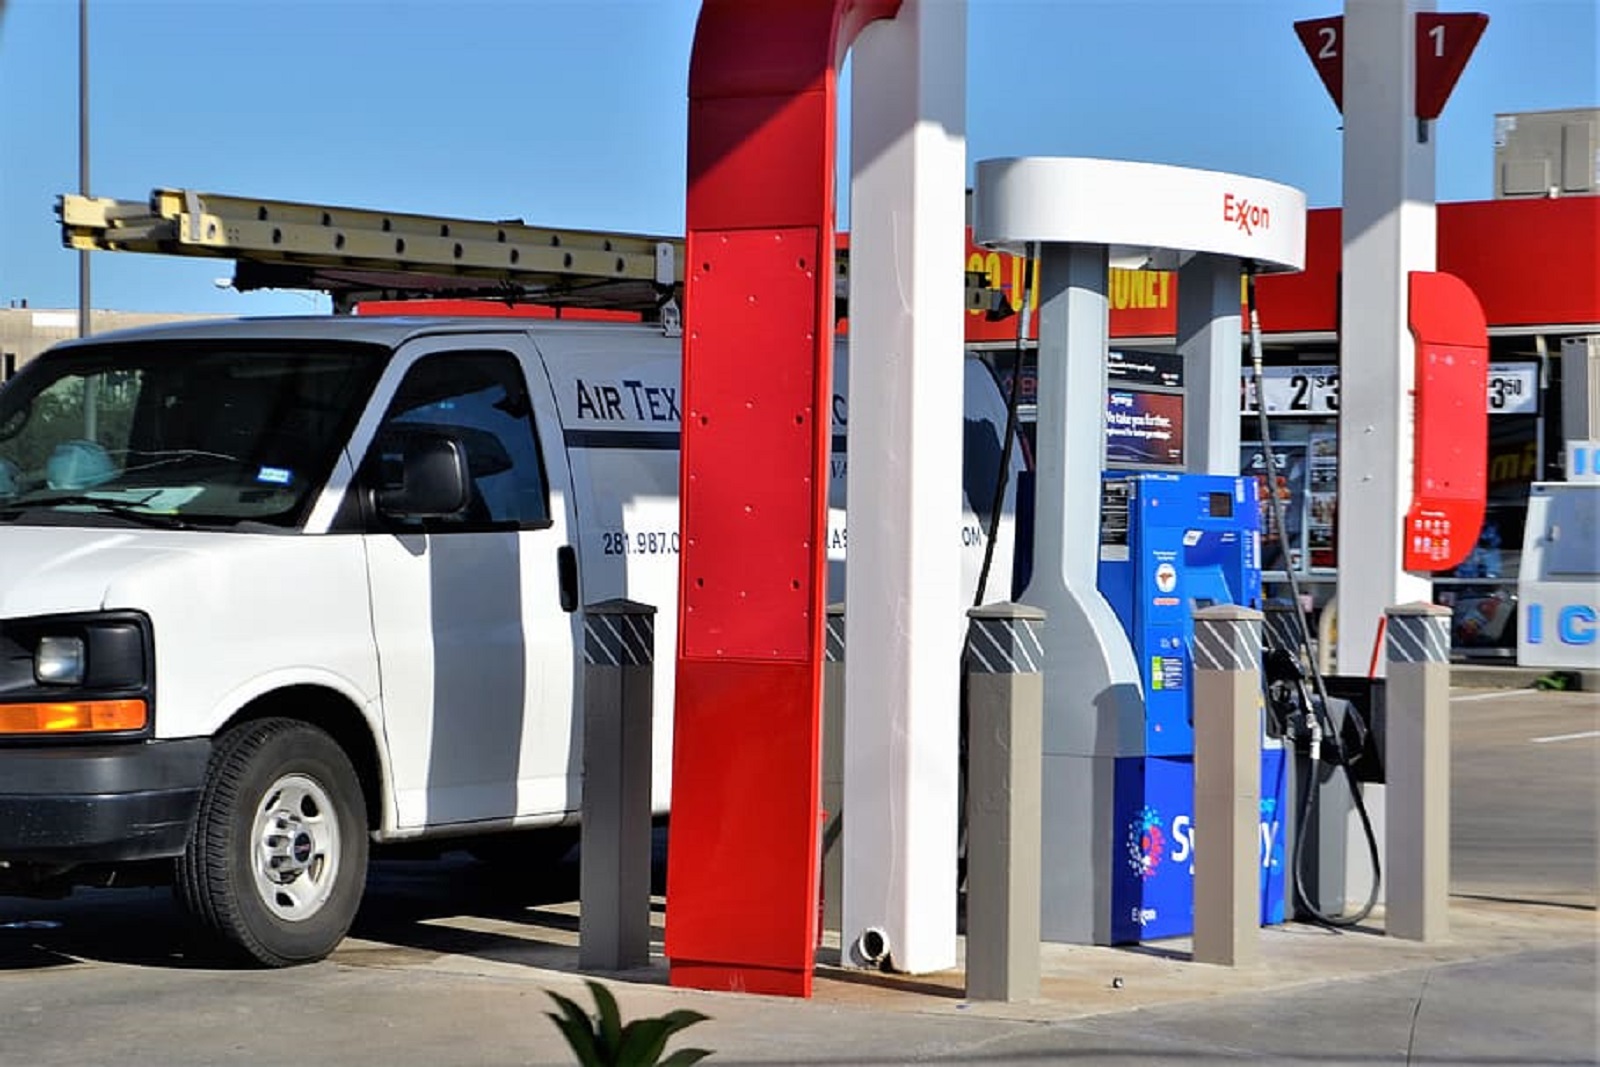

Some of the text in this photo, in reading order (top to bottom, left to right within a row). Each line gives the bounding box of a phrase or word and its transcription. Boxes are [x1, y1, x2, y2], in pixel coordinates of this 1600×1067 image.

[1318, 27, 1337, 59] 2
[1428, 25, 1445, 57] 1
[1223, 193, 1270, 236] Exxon
[576, 379, 625, 421] AIR
